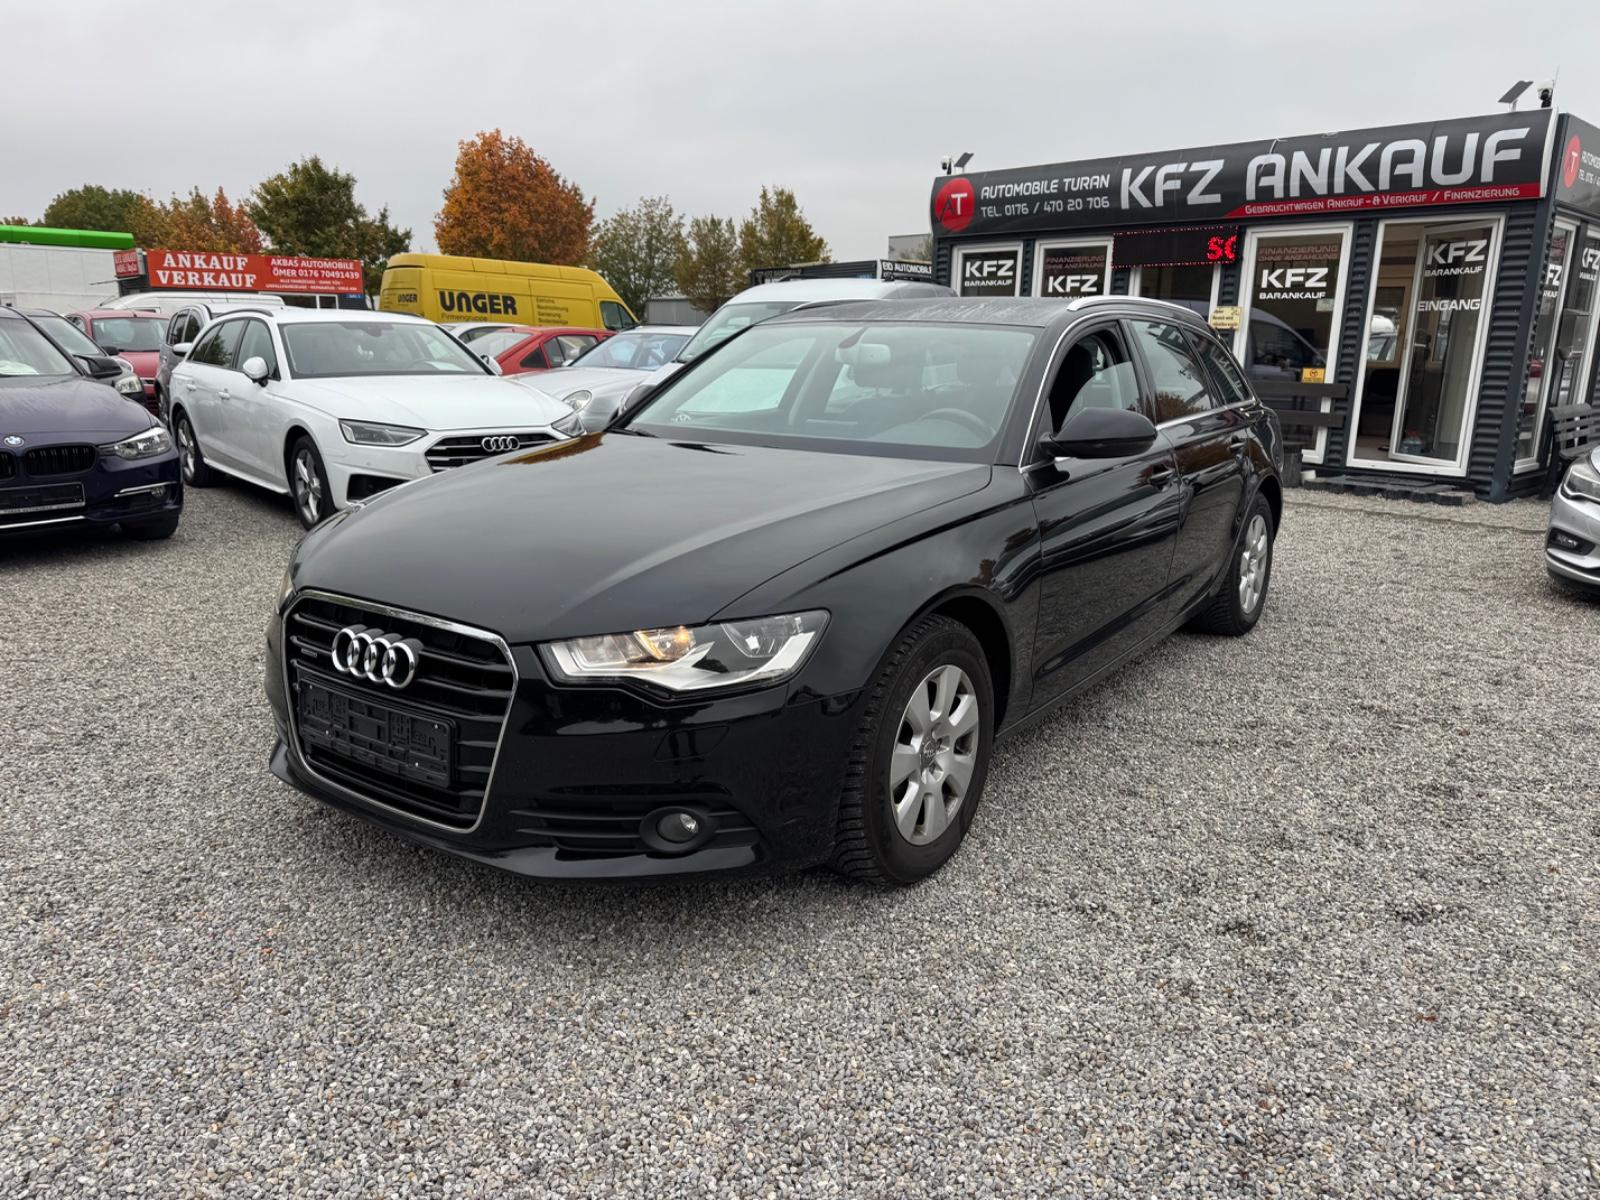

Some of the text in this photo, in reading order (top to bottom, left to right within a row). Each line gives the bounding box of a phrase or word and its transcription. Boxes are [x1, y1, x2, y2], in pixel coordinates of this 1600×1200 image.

[1120, 127, 1531, 210] KFZ ANKAUF
[981, 174, 1110, 200] AUTOMOBILE TURAN
[1444, 187, 1520, 200] FINANZIERUNG
[981, 196, 1110, 218] TEL. 0176 / 470 20 706
[1259, 245, 1339, 256] FINANZIERUNG
[1426, 239, 1488, 266] KFZ
[163, 253, 248, 271] ANKAUF
[271, 258, 354, 270] AKBAS AUTOMOBILE
[965, 260, 1014, 278] KFZ
[1424, 265, 1484, 277] BARANKAUF
[156, 270, 257, 288] VERKAUF
[298, 268, 319, 278] 0176
[1261, 267, 1329, 289] KFZ
[964, 278, 1013, 288] BARANKAUF
[1048, 274, 1098, 294] KFZ
[439, 291, 518, 316] UNGER
[1259, 291, 1327, 300] BARANKAUF
[1417, 298, 1481, 312] EINGANG
